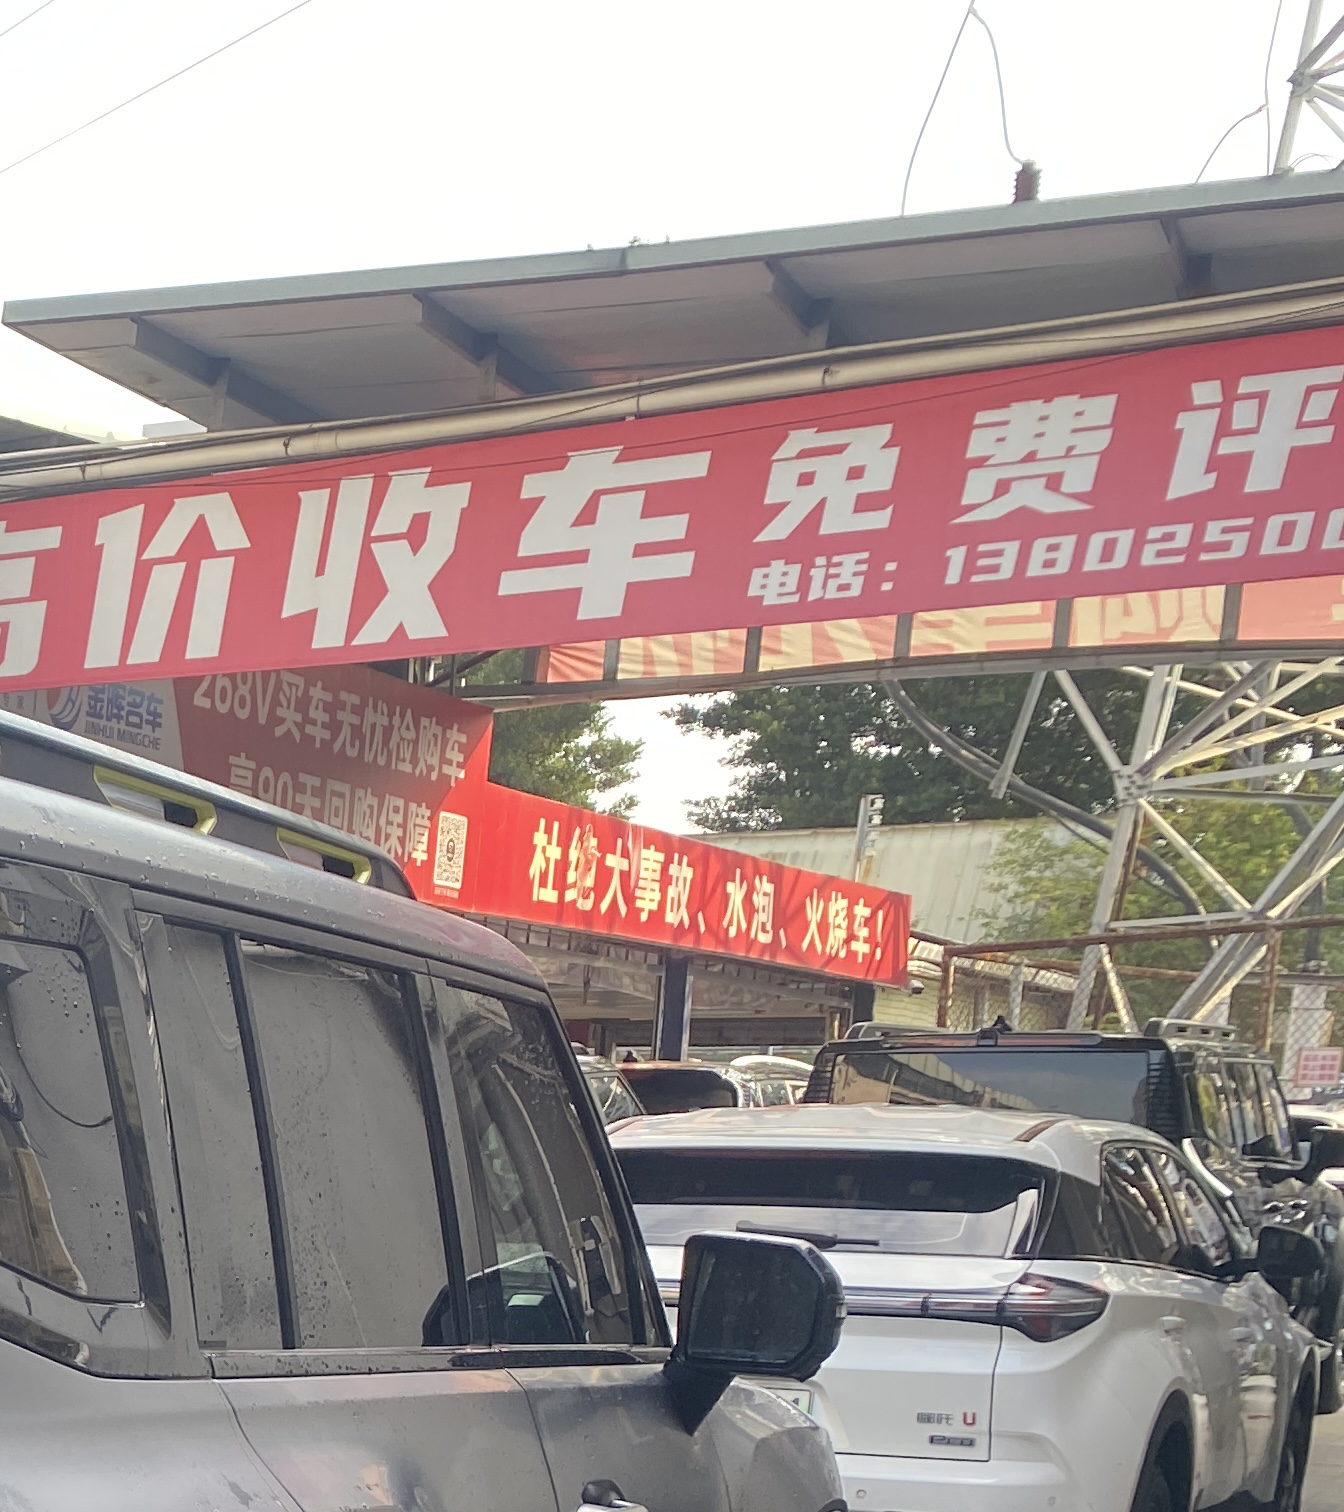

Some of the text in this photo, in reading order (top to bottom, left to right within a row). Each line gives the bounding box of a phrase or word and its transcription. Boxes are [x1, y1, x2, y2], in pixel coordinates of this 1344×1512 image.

[753, 364, 1344, 543] 免费评
[747, 552, 897, 607] 电话：
[84, 719, 161, 751] JINHUI MINGCHE
[962, 1411, 977, 1426] U
